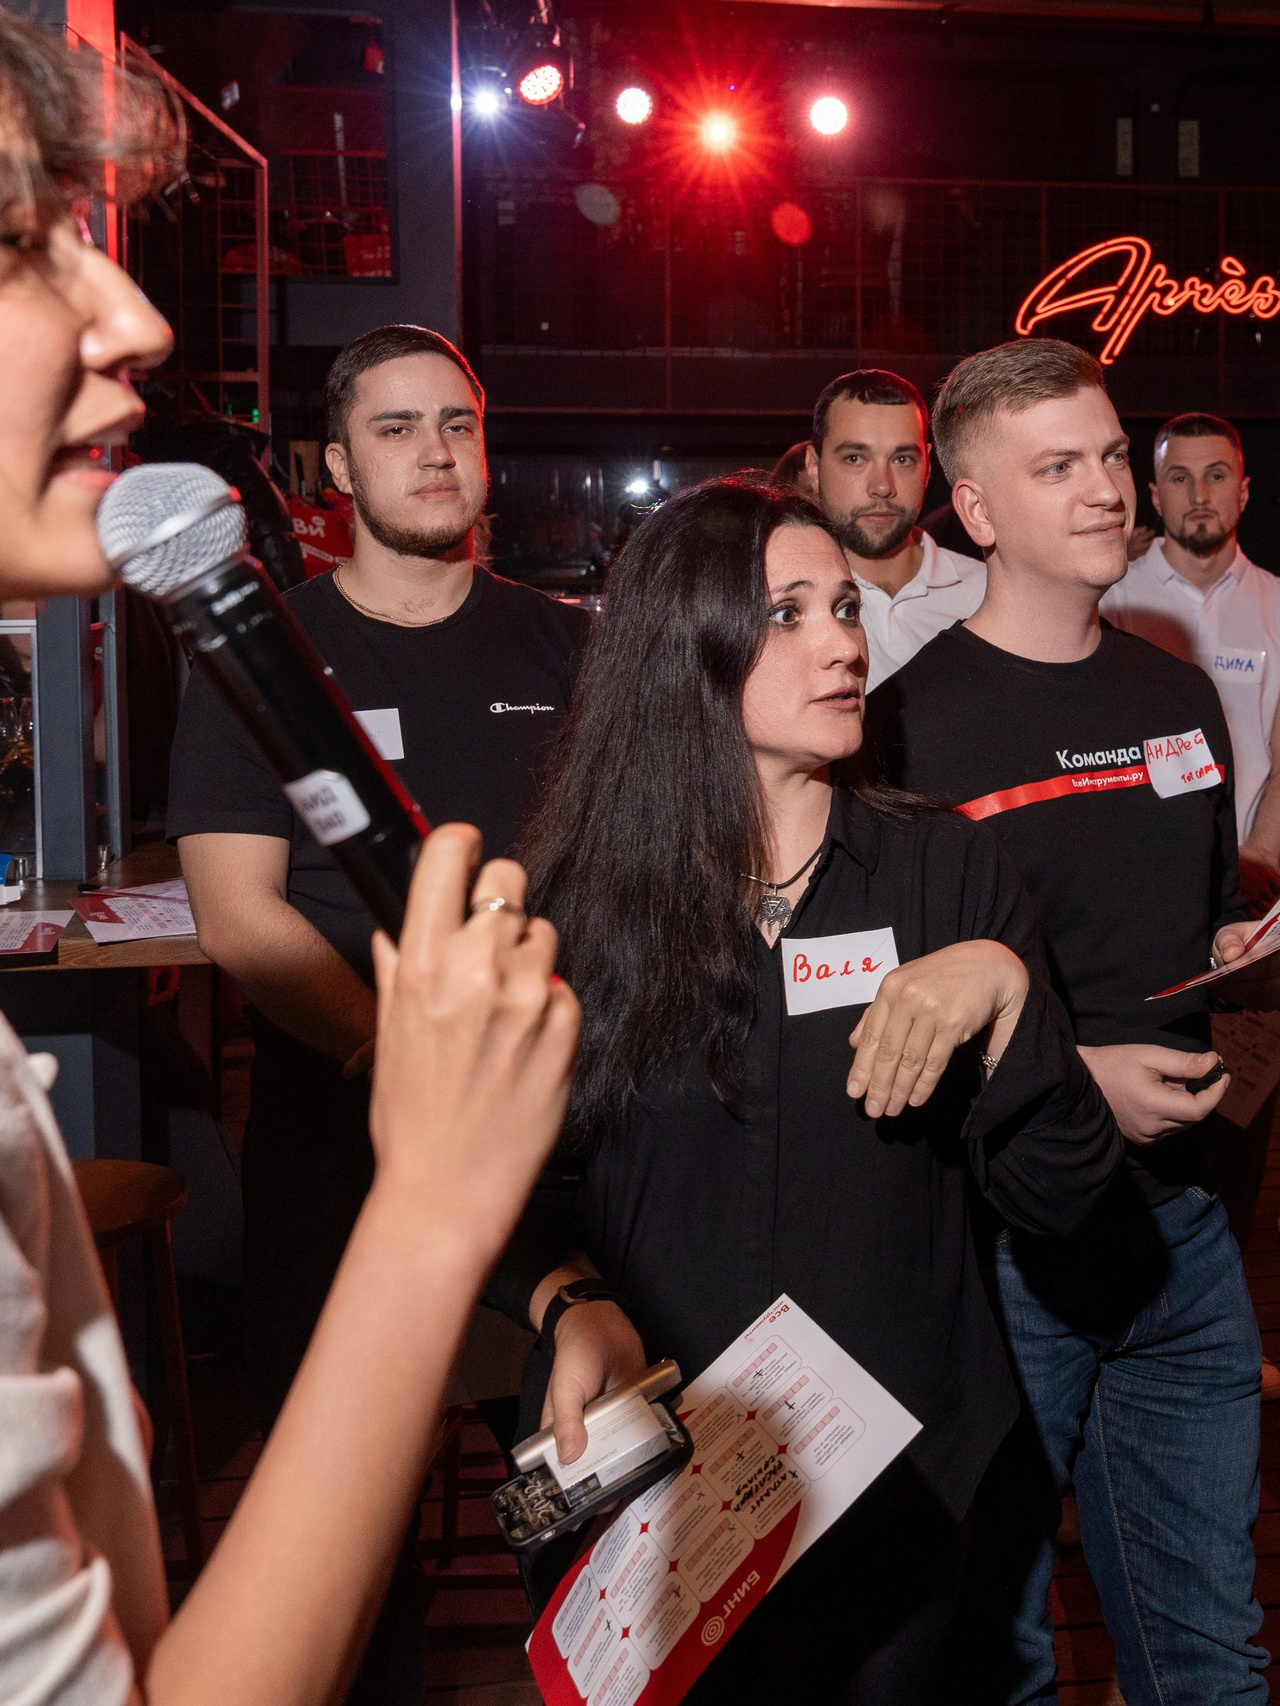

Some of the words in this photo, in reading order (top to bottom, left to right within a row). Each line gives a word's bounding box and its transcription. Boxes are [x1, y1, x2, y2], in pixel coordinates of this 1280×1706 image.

[490, 702, 555, 714] Champion
[1056, 746, 1142, 769] Команда
[792, 953, 884, 983] Валя
[768, 1303, 789, 1323] Все
